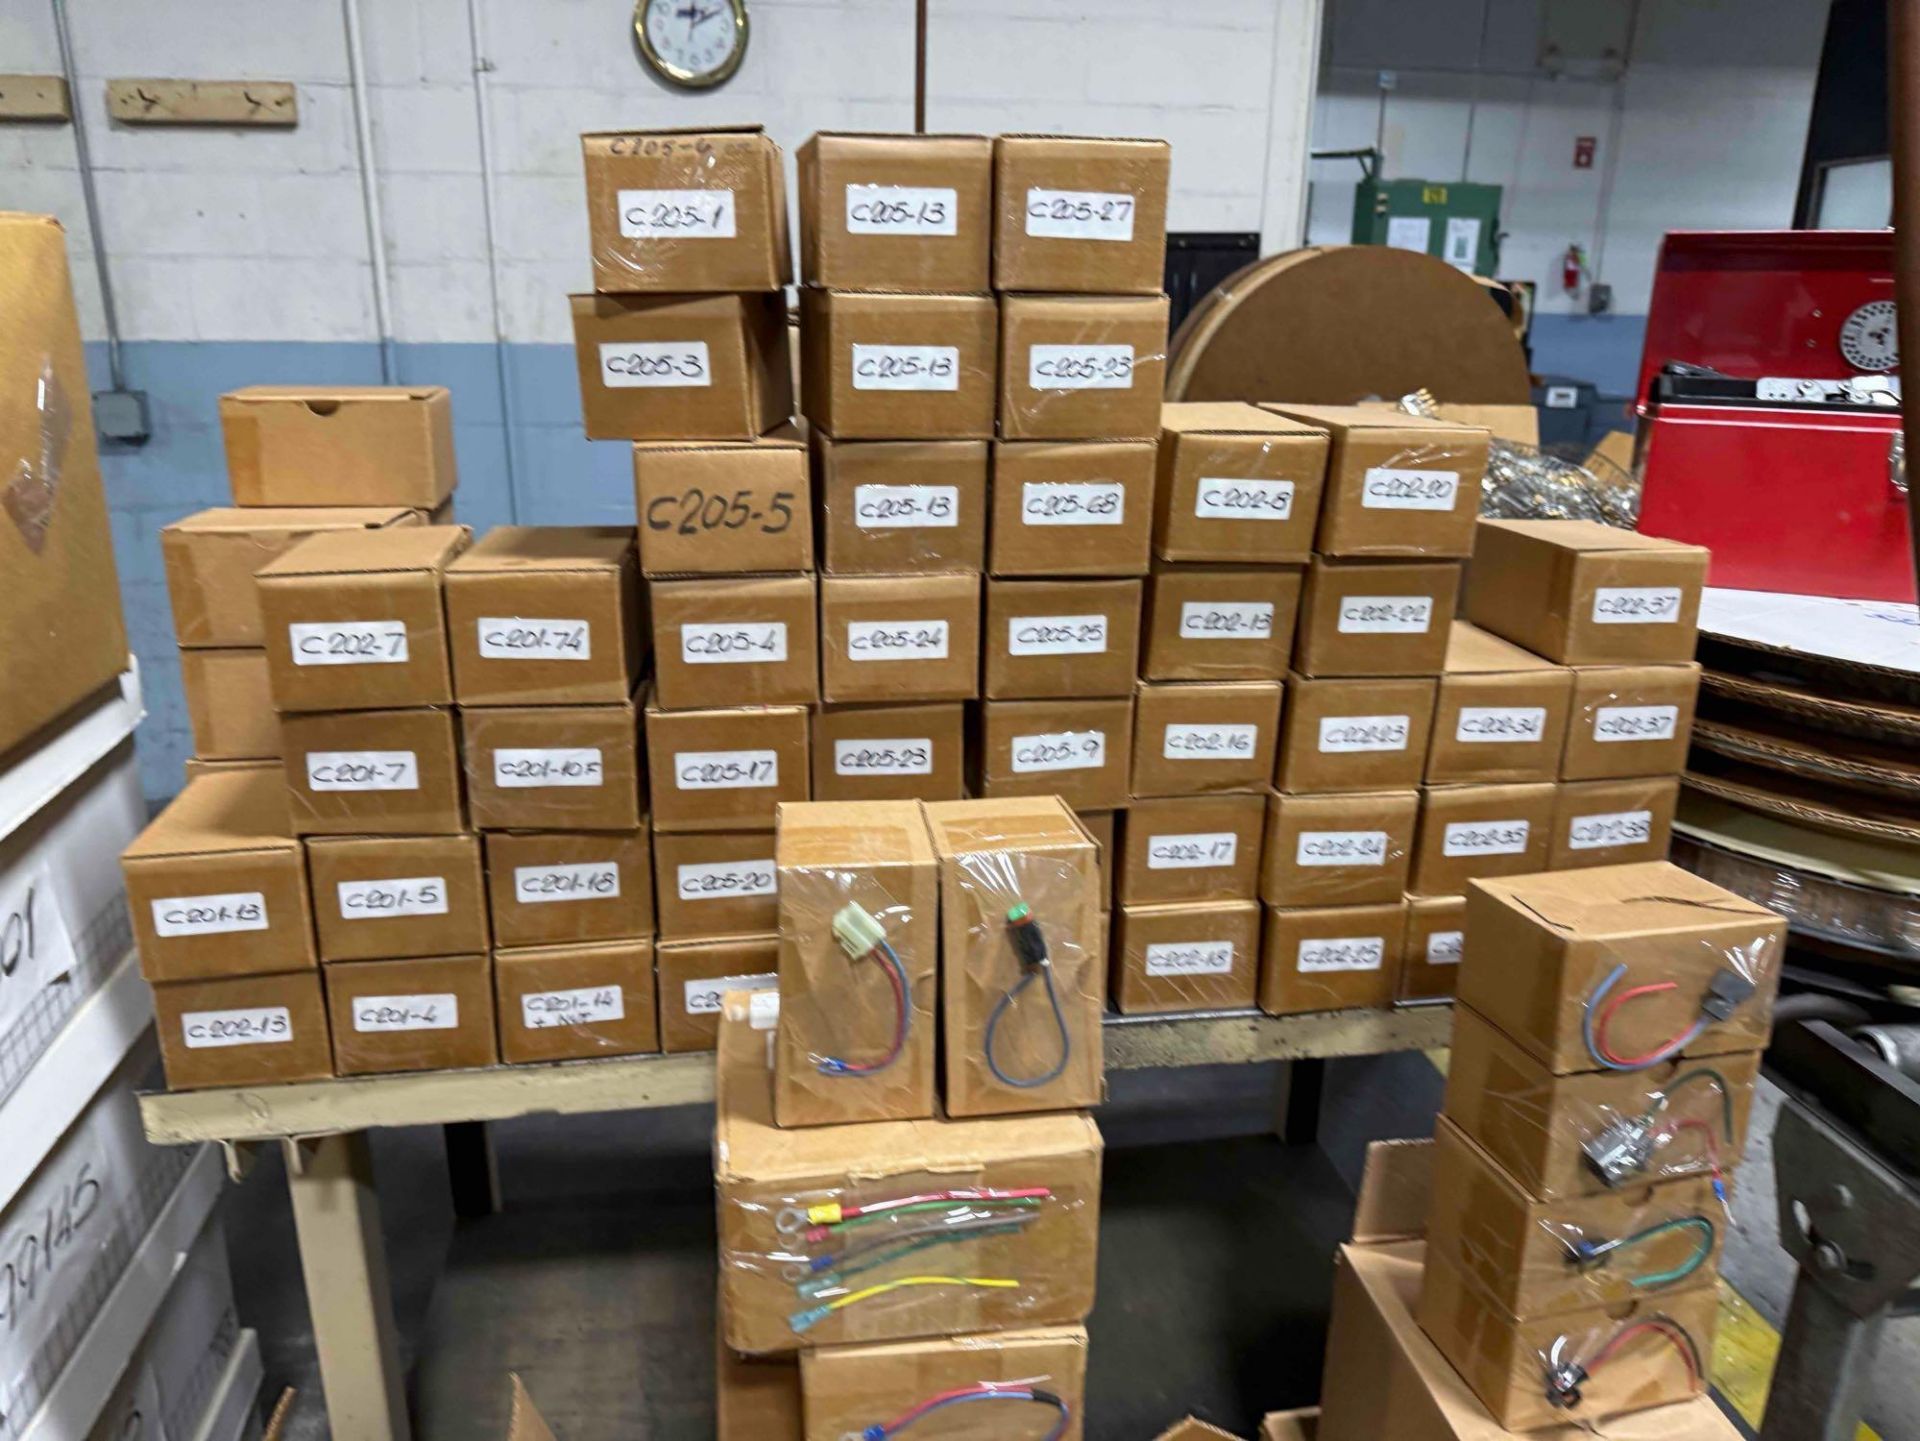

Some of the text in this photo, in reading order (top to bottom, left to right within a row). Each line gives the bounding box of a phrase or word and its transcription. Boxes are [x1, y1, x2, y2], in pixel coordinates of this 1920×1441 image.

[624, 202, 725, 230] C205-1
[850, 200, 946, 225] C205-13
[1026, 198, 1132, 222] C205-27
[605, 352, 704, 378] C205-3
[856, 355, 953, 379] C205-13
[1035, 355, 1133, 379] C205-23
[1368, 476, 1453, 499] C202-20
[646, 488, 795, 536] C205-5
[859, 495, 951, 519] C205-13
[1025, 492, 1121, 517] C205-68
[1343, 603, 1427, 623] C202-22
[1597, 595, 1678, 616] C202-37
[298, 631, 406, 657] C202-7
[484, 625, 585, 651] C201-74
[685, 629, 777, 655] C205-4
[850, 626, 942, 650] C205-24
[1016, 624, 1104, 645] C205-25
[1015, 739, 1100, 765] C205-9
[1167, 731, 1249, 751] C202-16
[839, 746, 928, 768] C205-23
[311, 762, 407, 784] C201-7
[681, 759, 774, 783] C205-17
[1151, 840, 1233, 861] C202-17
[520, 871, 616, 893] C201-18
[681, 871, 772, 893] C205-20
[345, 884, 439, 909] C201-5
[359, 1004, 438, 1025] C201-4
[187, 1014, 287, 1040] C202-13
